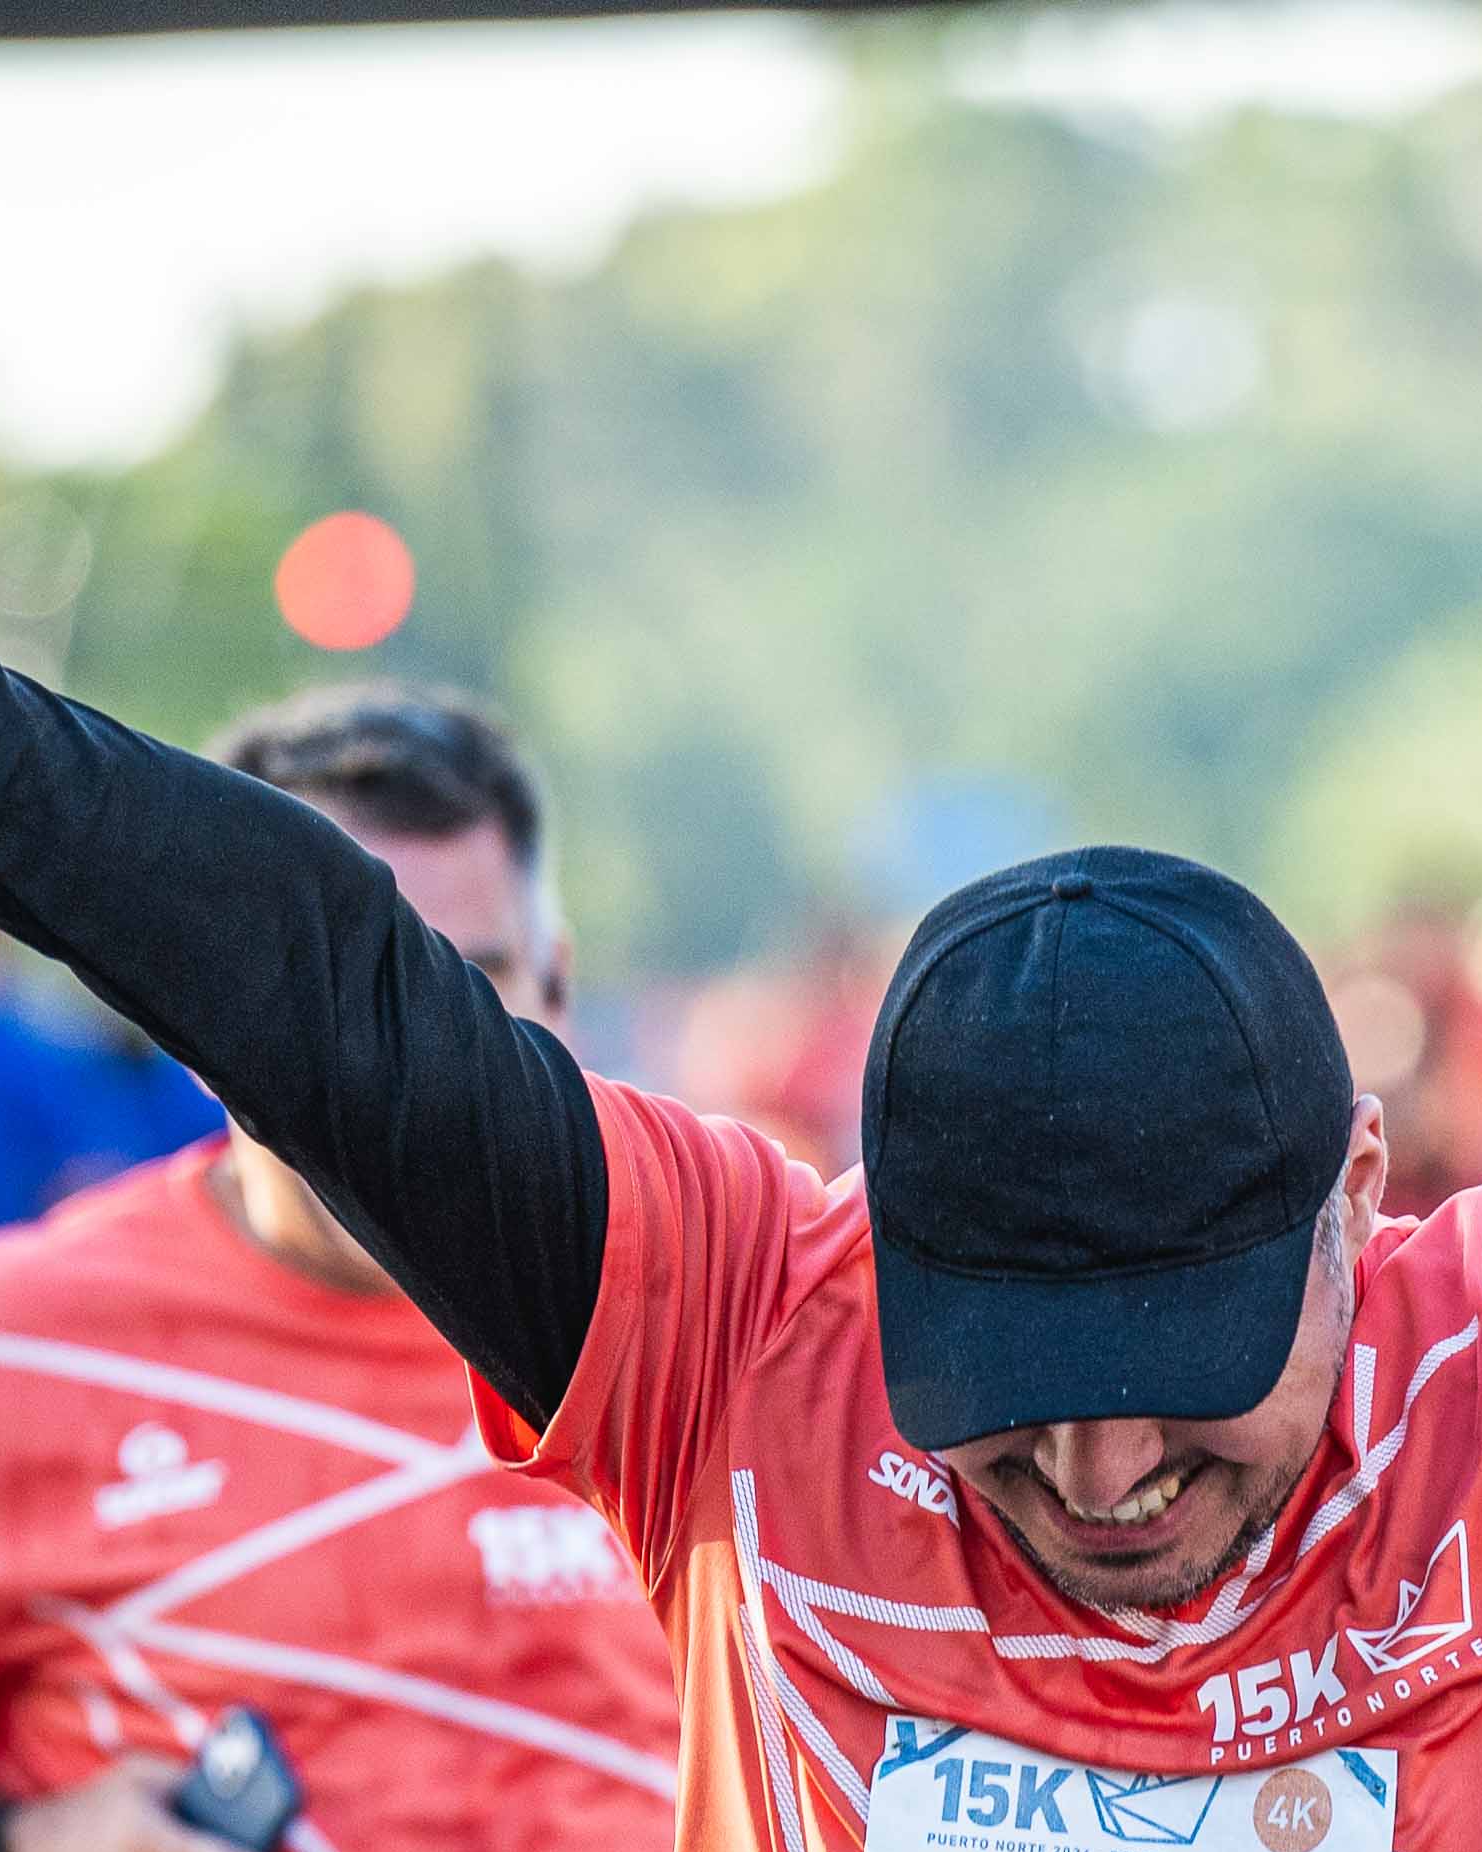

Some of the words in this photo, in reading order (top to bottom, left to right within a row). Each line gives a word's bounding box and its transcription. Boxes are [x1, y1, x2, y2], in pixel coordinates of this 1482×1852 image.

[1196, 1631, 1347, 1742] 15K
[1210, 1707, 1352, 1765] PUERTO
[934, 1758, 1073, 1833] 15K
[1267, 1795, 1318, 1833] 4K
[927, 1832, 990, 1850] PUERTO
